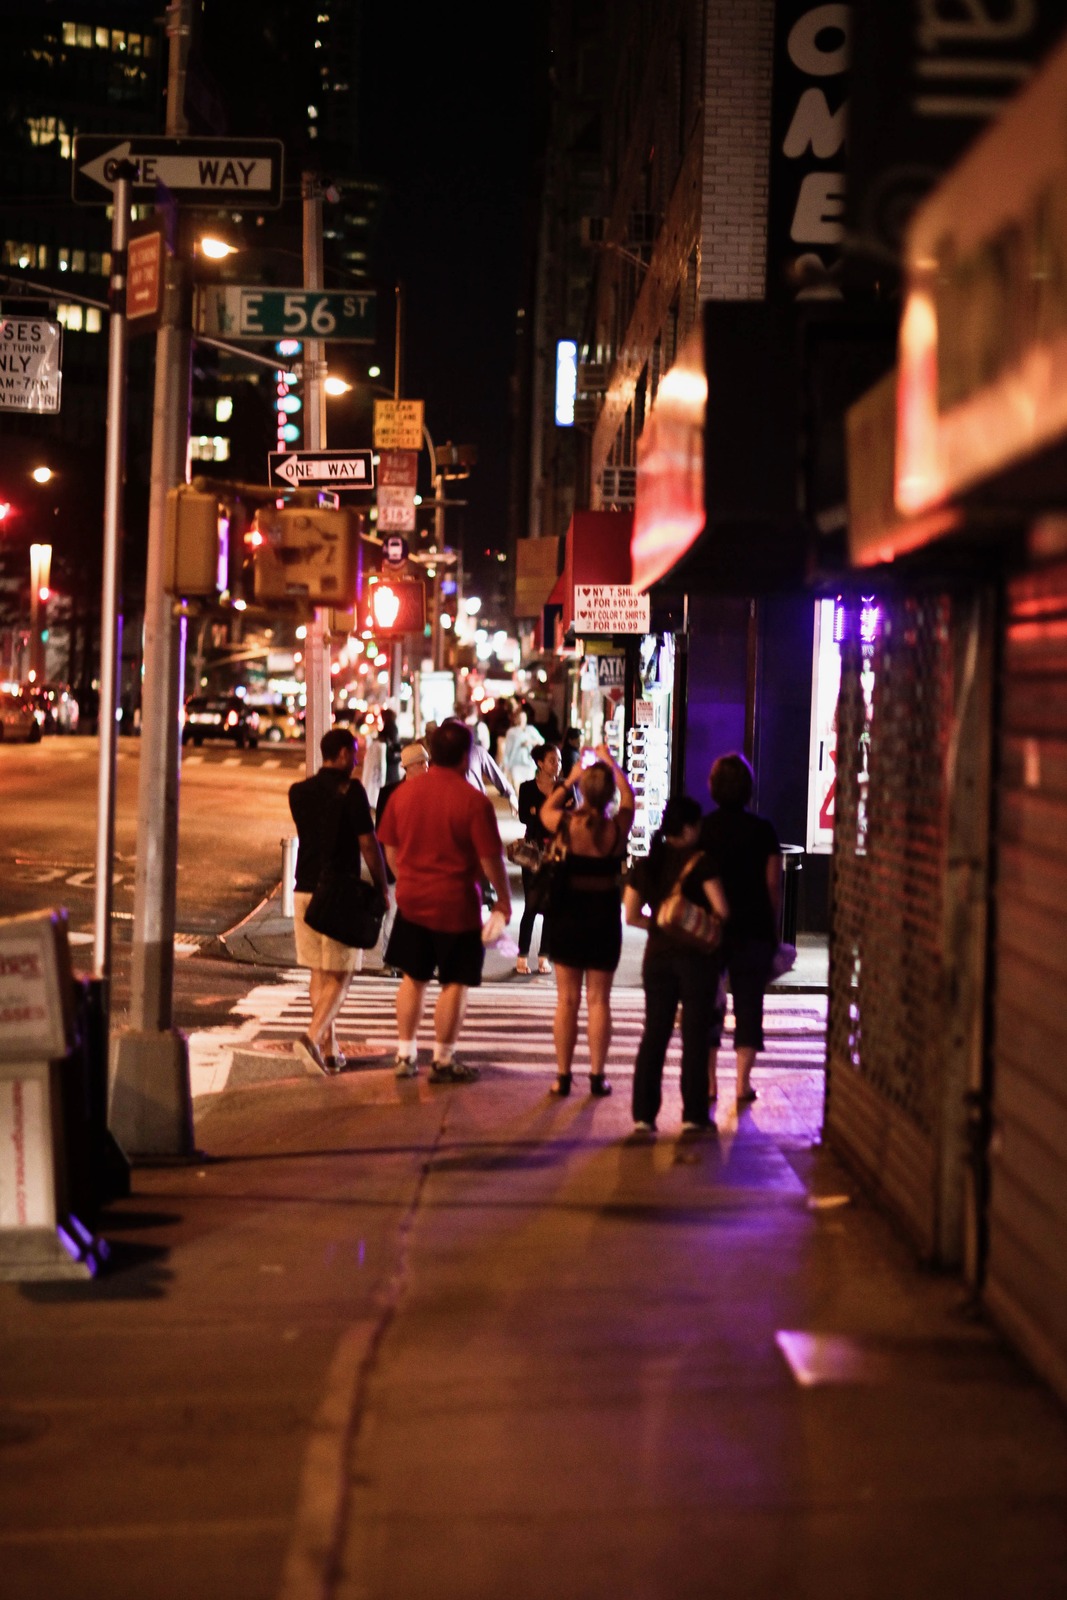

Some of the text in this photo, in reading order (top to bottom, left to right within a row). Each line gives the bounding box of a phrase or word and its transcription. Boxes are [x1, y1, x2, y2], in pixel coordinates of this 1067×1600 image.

[198, 160, 256, 186] WAY
[241, 293, 369, 335] E 56 ST
[12, 343, 46, 354] TURNS
[285, 462, 358, 478] ONE WAY
[592, 587, 604, 597] NY
[617, 587, 648, 598] SHIS
[586, 600, 592, 609] 4
[593, 598, 611, 608] FOR
[587, 610, 597, 620] NY
[625, 610, 647, 621] SHIRTS
[593, 621, 610, 631] FOR
